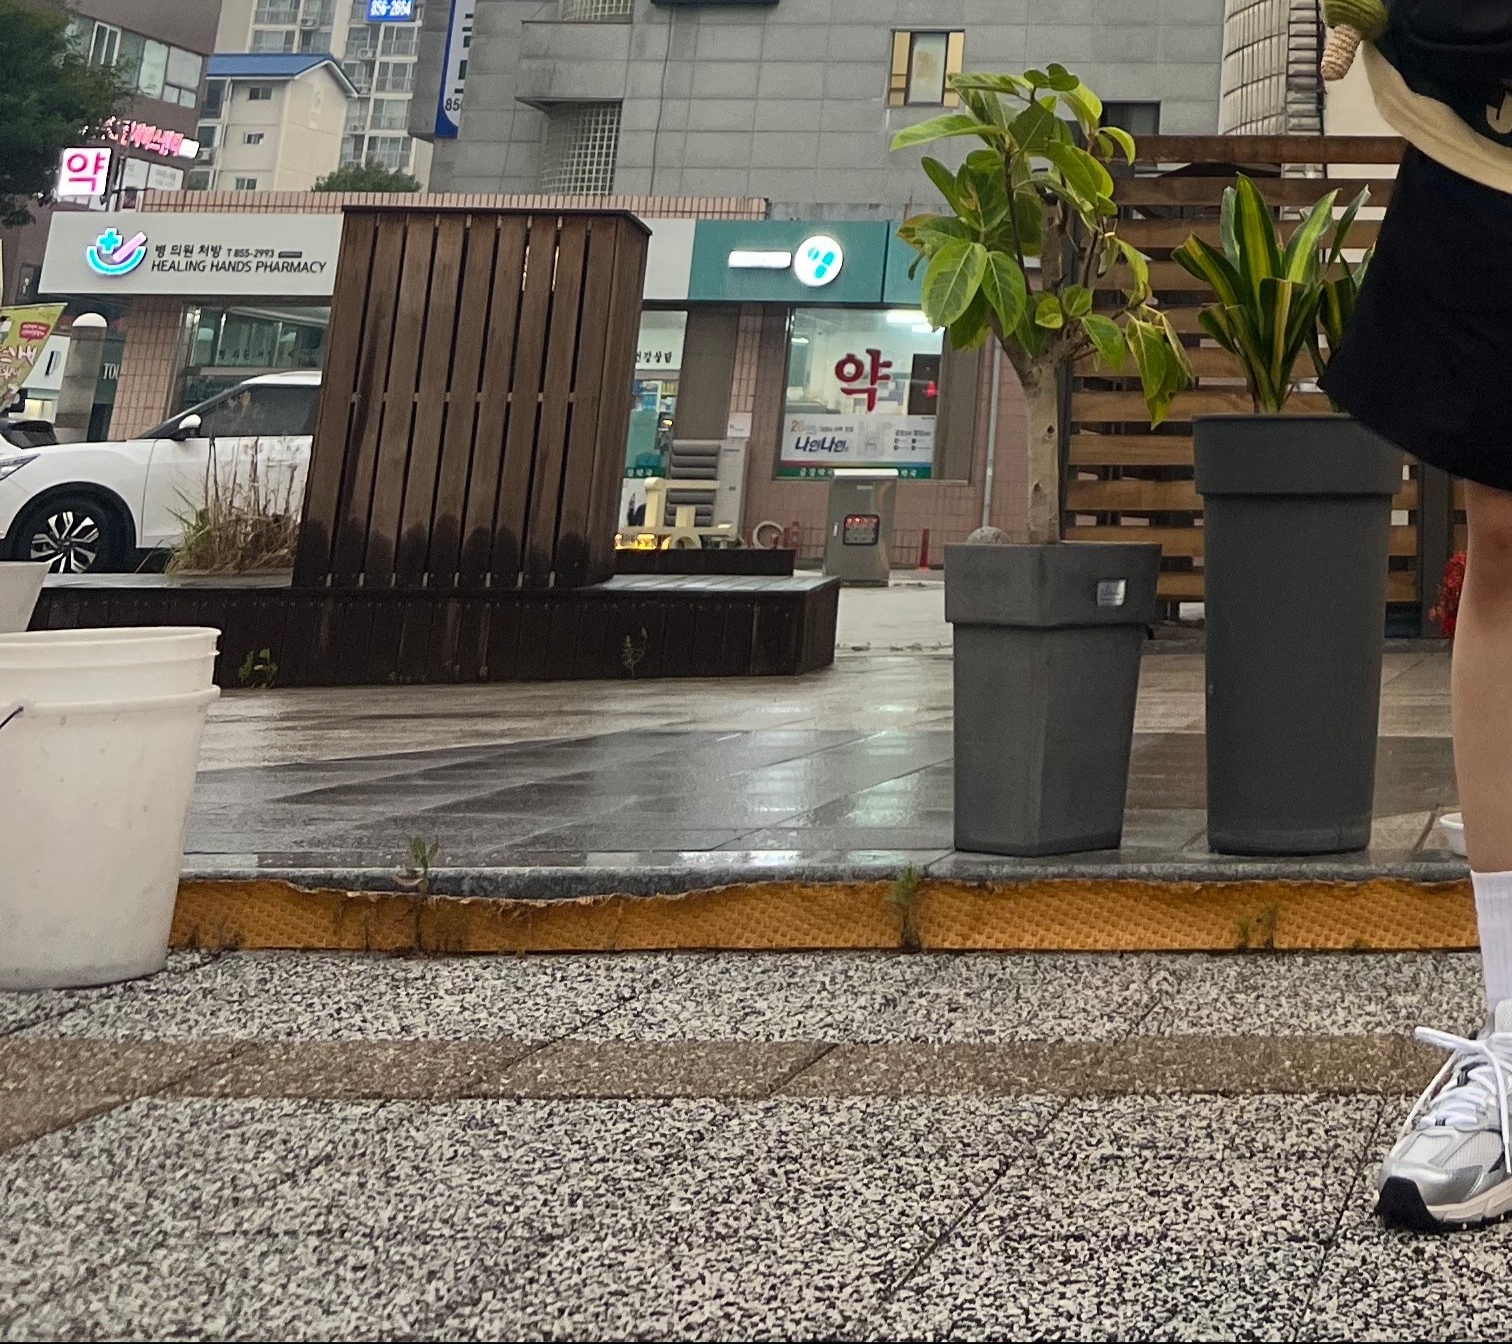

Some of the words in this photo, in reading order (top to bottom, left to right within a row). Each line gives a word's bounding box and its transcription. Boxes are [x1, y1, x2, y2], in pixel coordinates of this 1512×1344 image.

[65, 151, 107, 193] 약
[155, 244, 166, 258] 병
[170, 244, 194, 258] 의원
[198, 244, 222, 258] 처방
[233, 248, 275, 258] 855-2993
[151, 260, 206, 273] HEALING
[210, 261, 252, 273] HANDS
[255, 261, 327, 274] PHARMACY
[834, 347, 893, 413] 약
